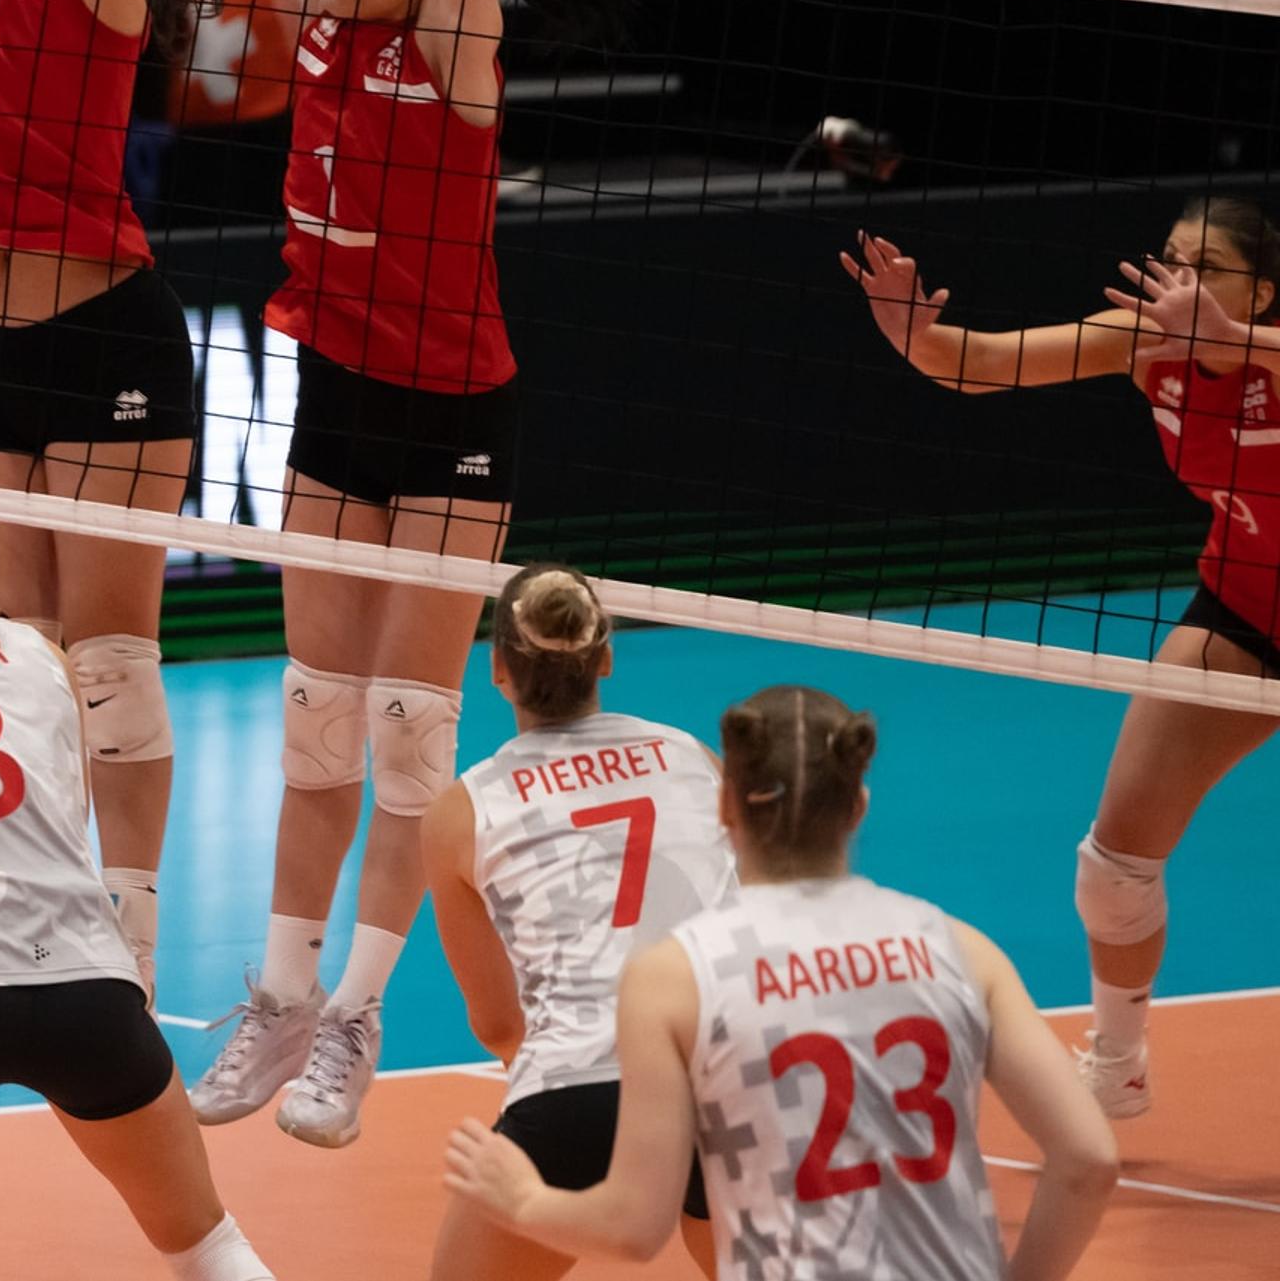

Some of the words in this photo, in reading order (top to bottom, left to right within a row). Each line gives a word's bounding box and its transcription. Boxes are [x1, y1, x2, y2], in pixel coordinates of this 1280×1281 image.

[1211, 489, 1259, 535] 9
[511, 740, 668, 803] PIERRET
[570, 796, 656, 928] 7
[755, 936, 936, 1005] AARDEN
[769, 1015, 957, 1204] 23
